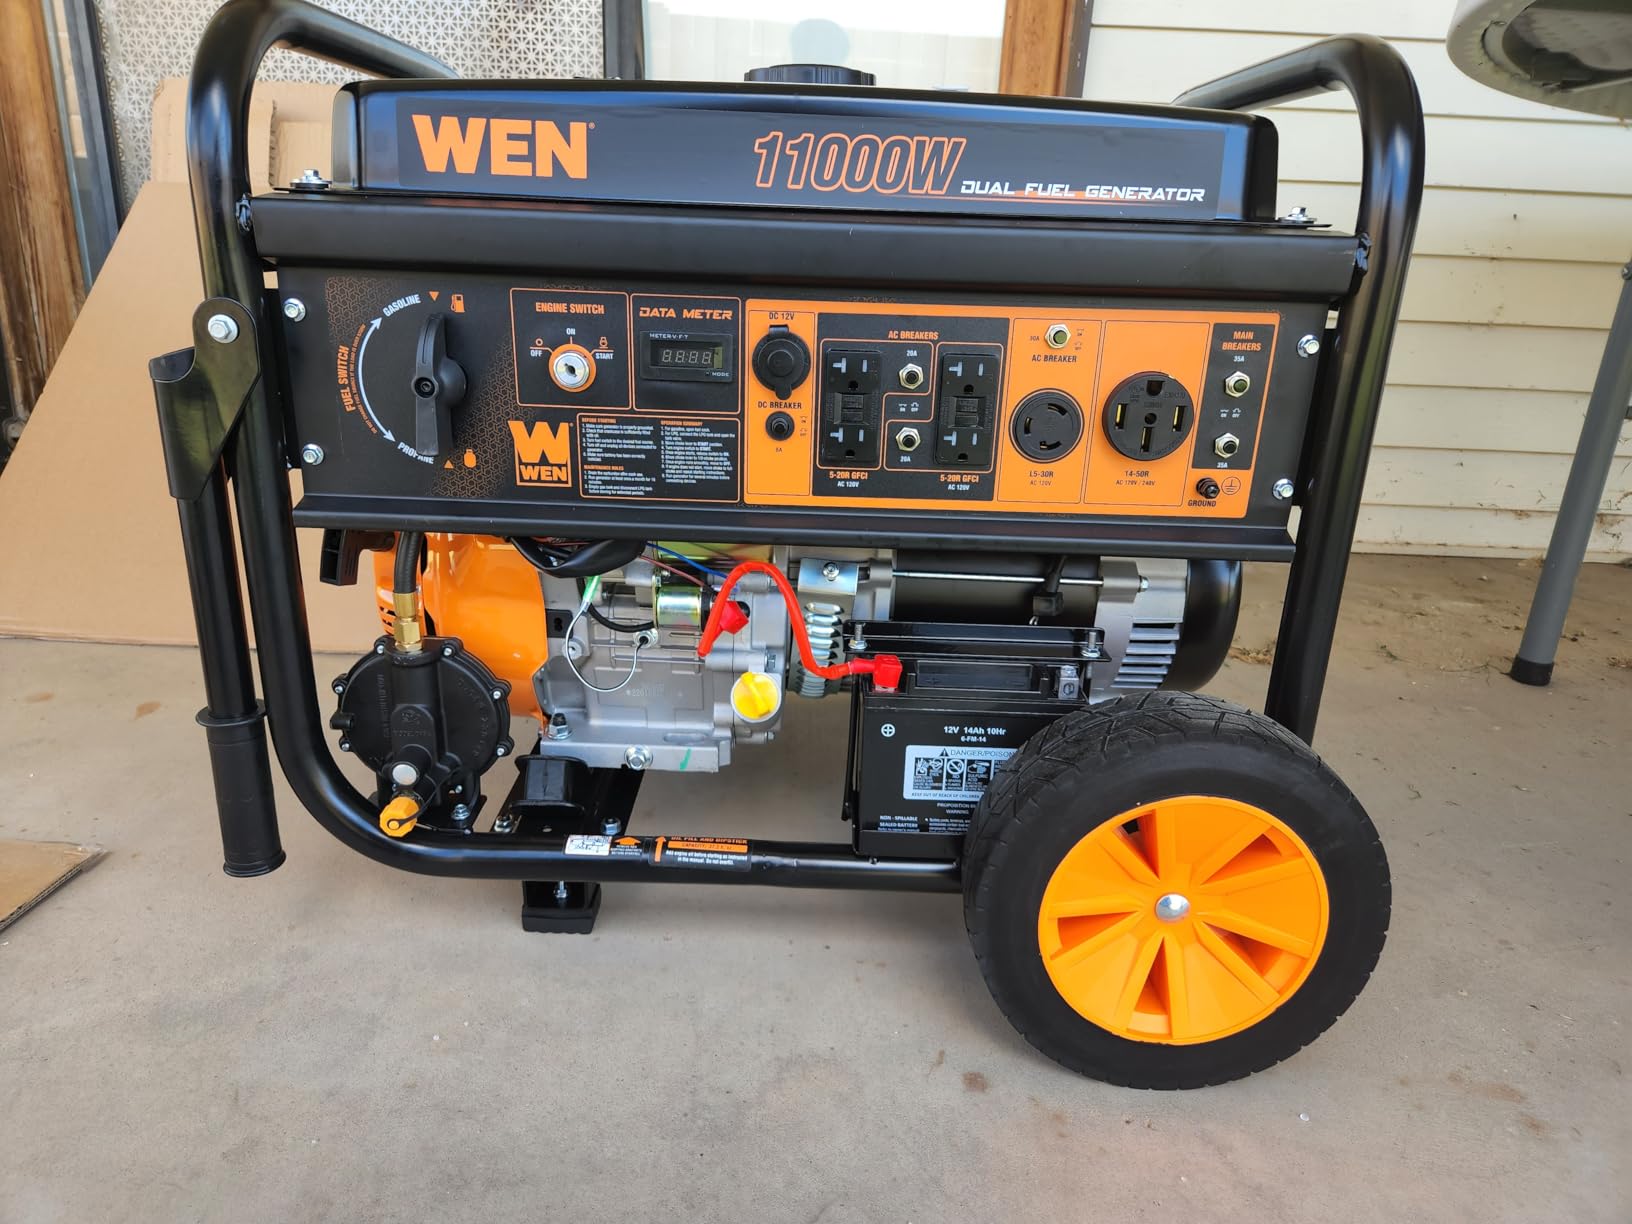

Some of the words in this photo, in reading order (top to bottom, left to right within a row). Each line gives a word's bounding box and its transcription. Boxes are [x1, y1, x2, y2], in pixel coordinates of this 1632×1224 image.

[412, 114, 588, 179] WEN
[753, 131, 968, 196] 11000W
[960, 181, 1013, 196] DUAL
[1022, 182, 1076, 198] FUEL
[1084, 185, 1206, 203] GENERATOR
[382, 294, 421, 317] GASOLINE
[535, 302, 568, 314] ENGINE
[569, 303, 605, 315] SWITCH
[639, 307, 677, 319] DATA
[682, 309, 733, 321] METER
[768, 312, 780, 320] DC
[781, 313, 795, 321] 12V
[566, 328, 576, 336] ON
[888, 330, 899, 339] AC
[900, 331, 939, 341] BREAKERS
[1233, 330, 1254, 341] MAIN
[1221, 341, 1262, 352] BREAKERS
[530, 349, 543, 358] OFF
[595, 352, 614, 360] START
[906, 350, 918, 358] 20A
[1031, 354, 1042, 362] AC
[1043, 354, 1077, 363] BREAKER
[1233, 355, 1245, 363] 35A
[337, 344, 350, 385] SWITCH
[340, 386, 356, 412] FUEL
[757, 401, 768, 409] DC
[769, 401, 802, 410] BREAKER
[900, 455, 911, 463] 20A
[519, 464, 567, 482] WEN
[829, 471, 850, 480] 5-20R
[851, 472, 868, 481] GFCI
[940, 473, 961, 482] 5-20R
[962, 474, 979, 483] GFCI
[1029, 470, 1054, 479] L5-30R
[1124, 470, 1149, 478] 14-50R
[1187, 499, 1217, 508] GROUND
[943, 726, 960, 735] 12V
[963, 726, 985, 736] 14Ah
[987, 727, 1006, 737] 10Hr
